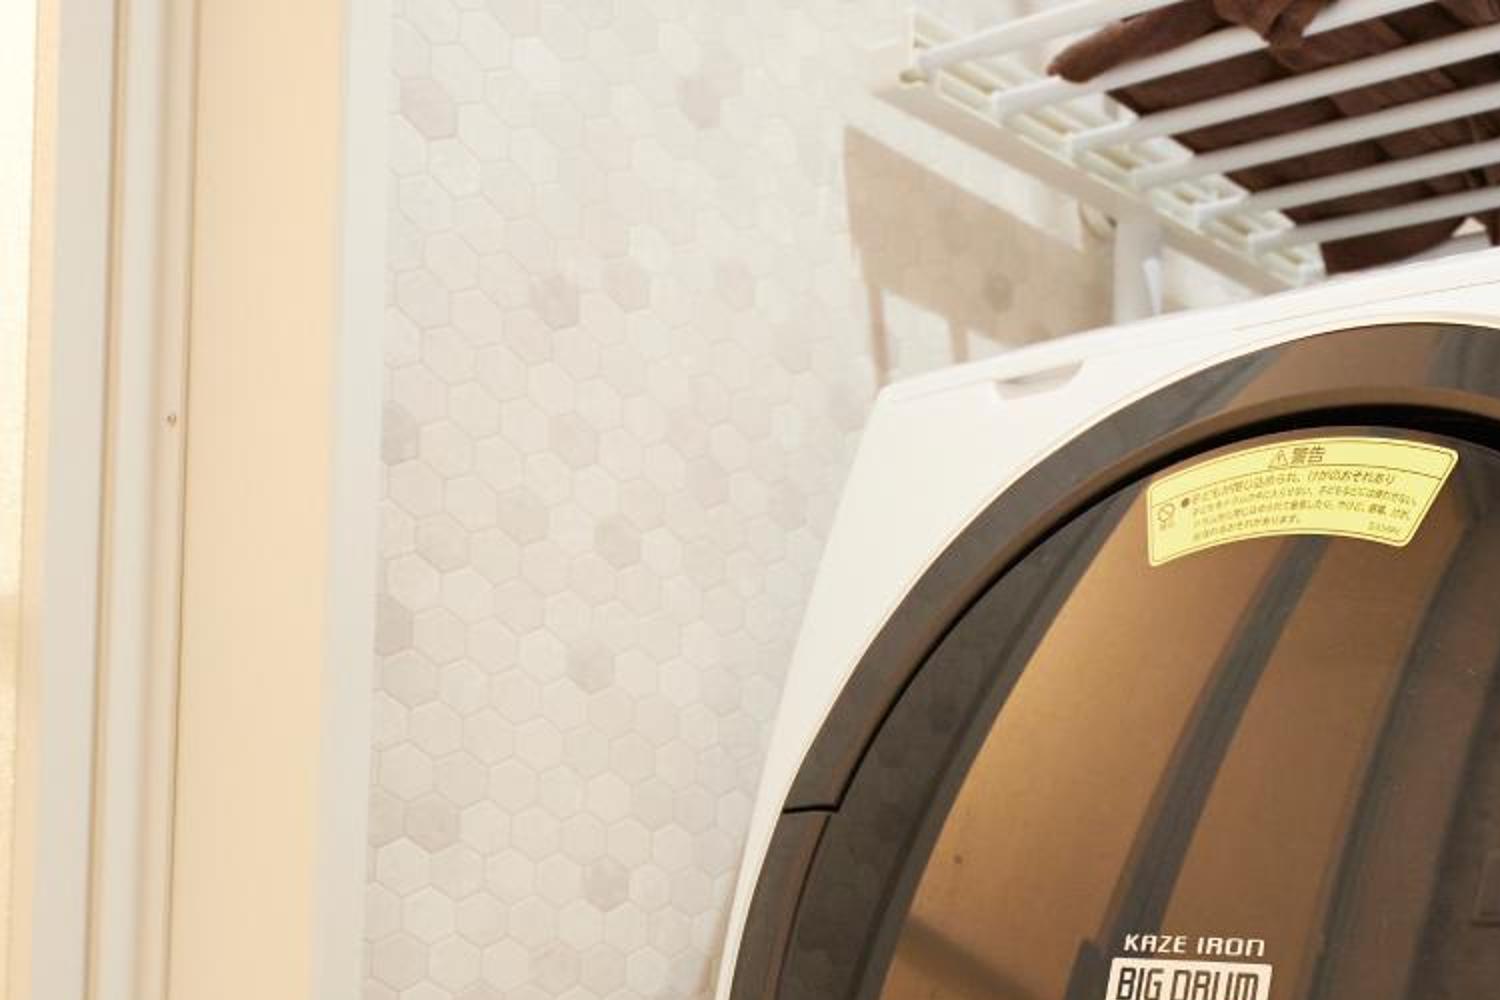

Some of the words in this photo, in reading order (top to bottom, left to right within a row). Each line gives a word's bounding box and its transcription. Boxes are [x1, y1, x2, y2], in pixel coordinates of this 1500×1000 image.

[1291, 445, 1326, 465] 警告
[1123, 933, 1188, 953] KAZE
[1197, 937, 1265, 957] IRON
